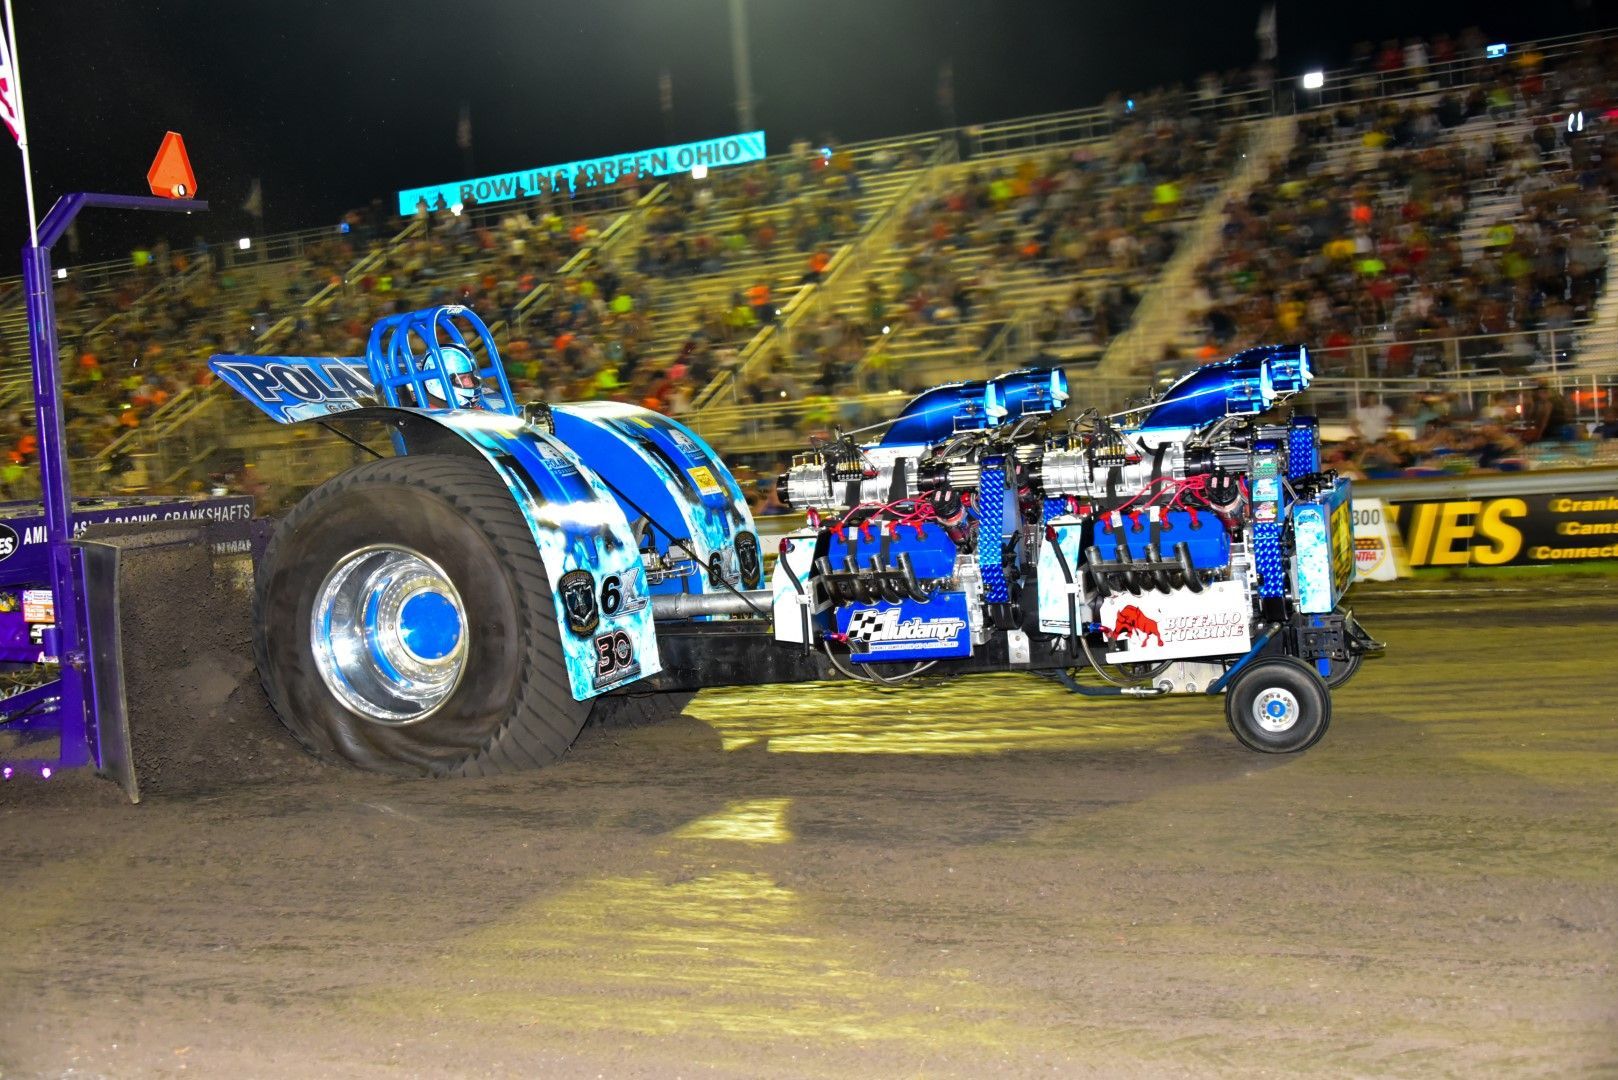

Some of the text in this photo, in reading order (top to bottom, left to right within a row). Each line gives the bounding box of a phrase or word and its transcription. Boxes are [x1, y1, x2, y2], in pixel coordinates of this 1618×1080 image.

[677, 140, 741, 167] OHIO
[1165, 611, 1242, 630] BUFFALO
[1164, 624, 1245, 643] TURBINE
